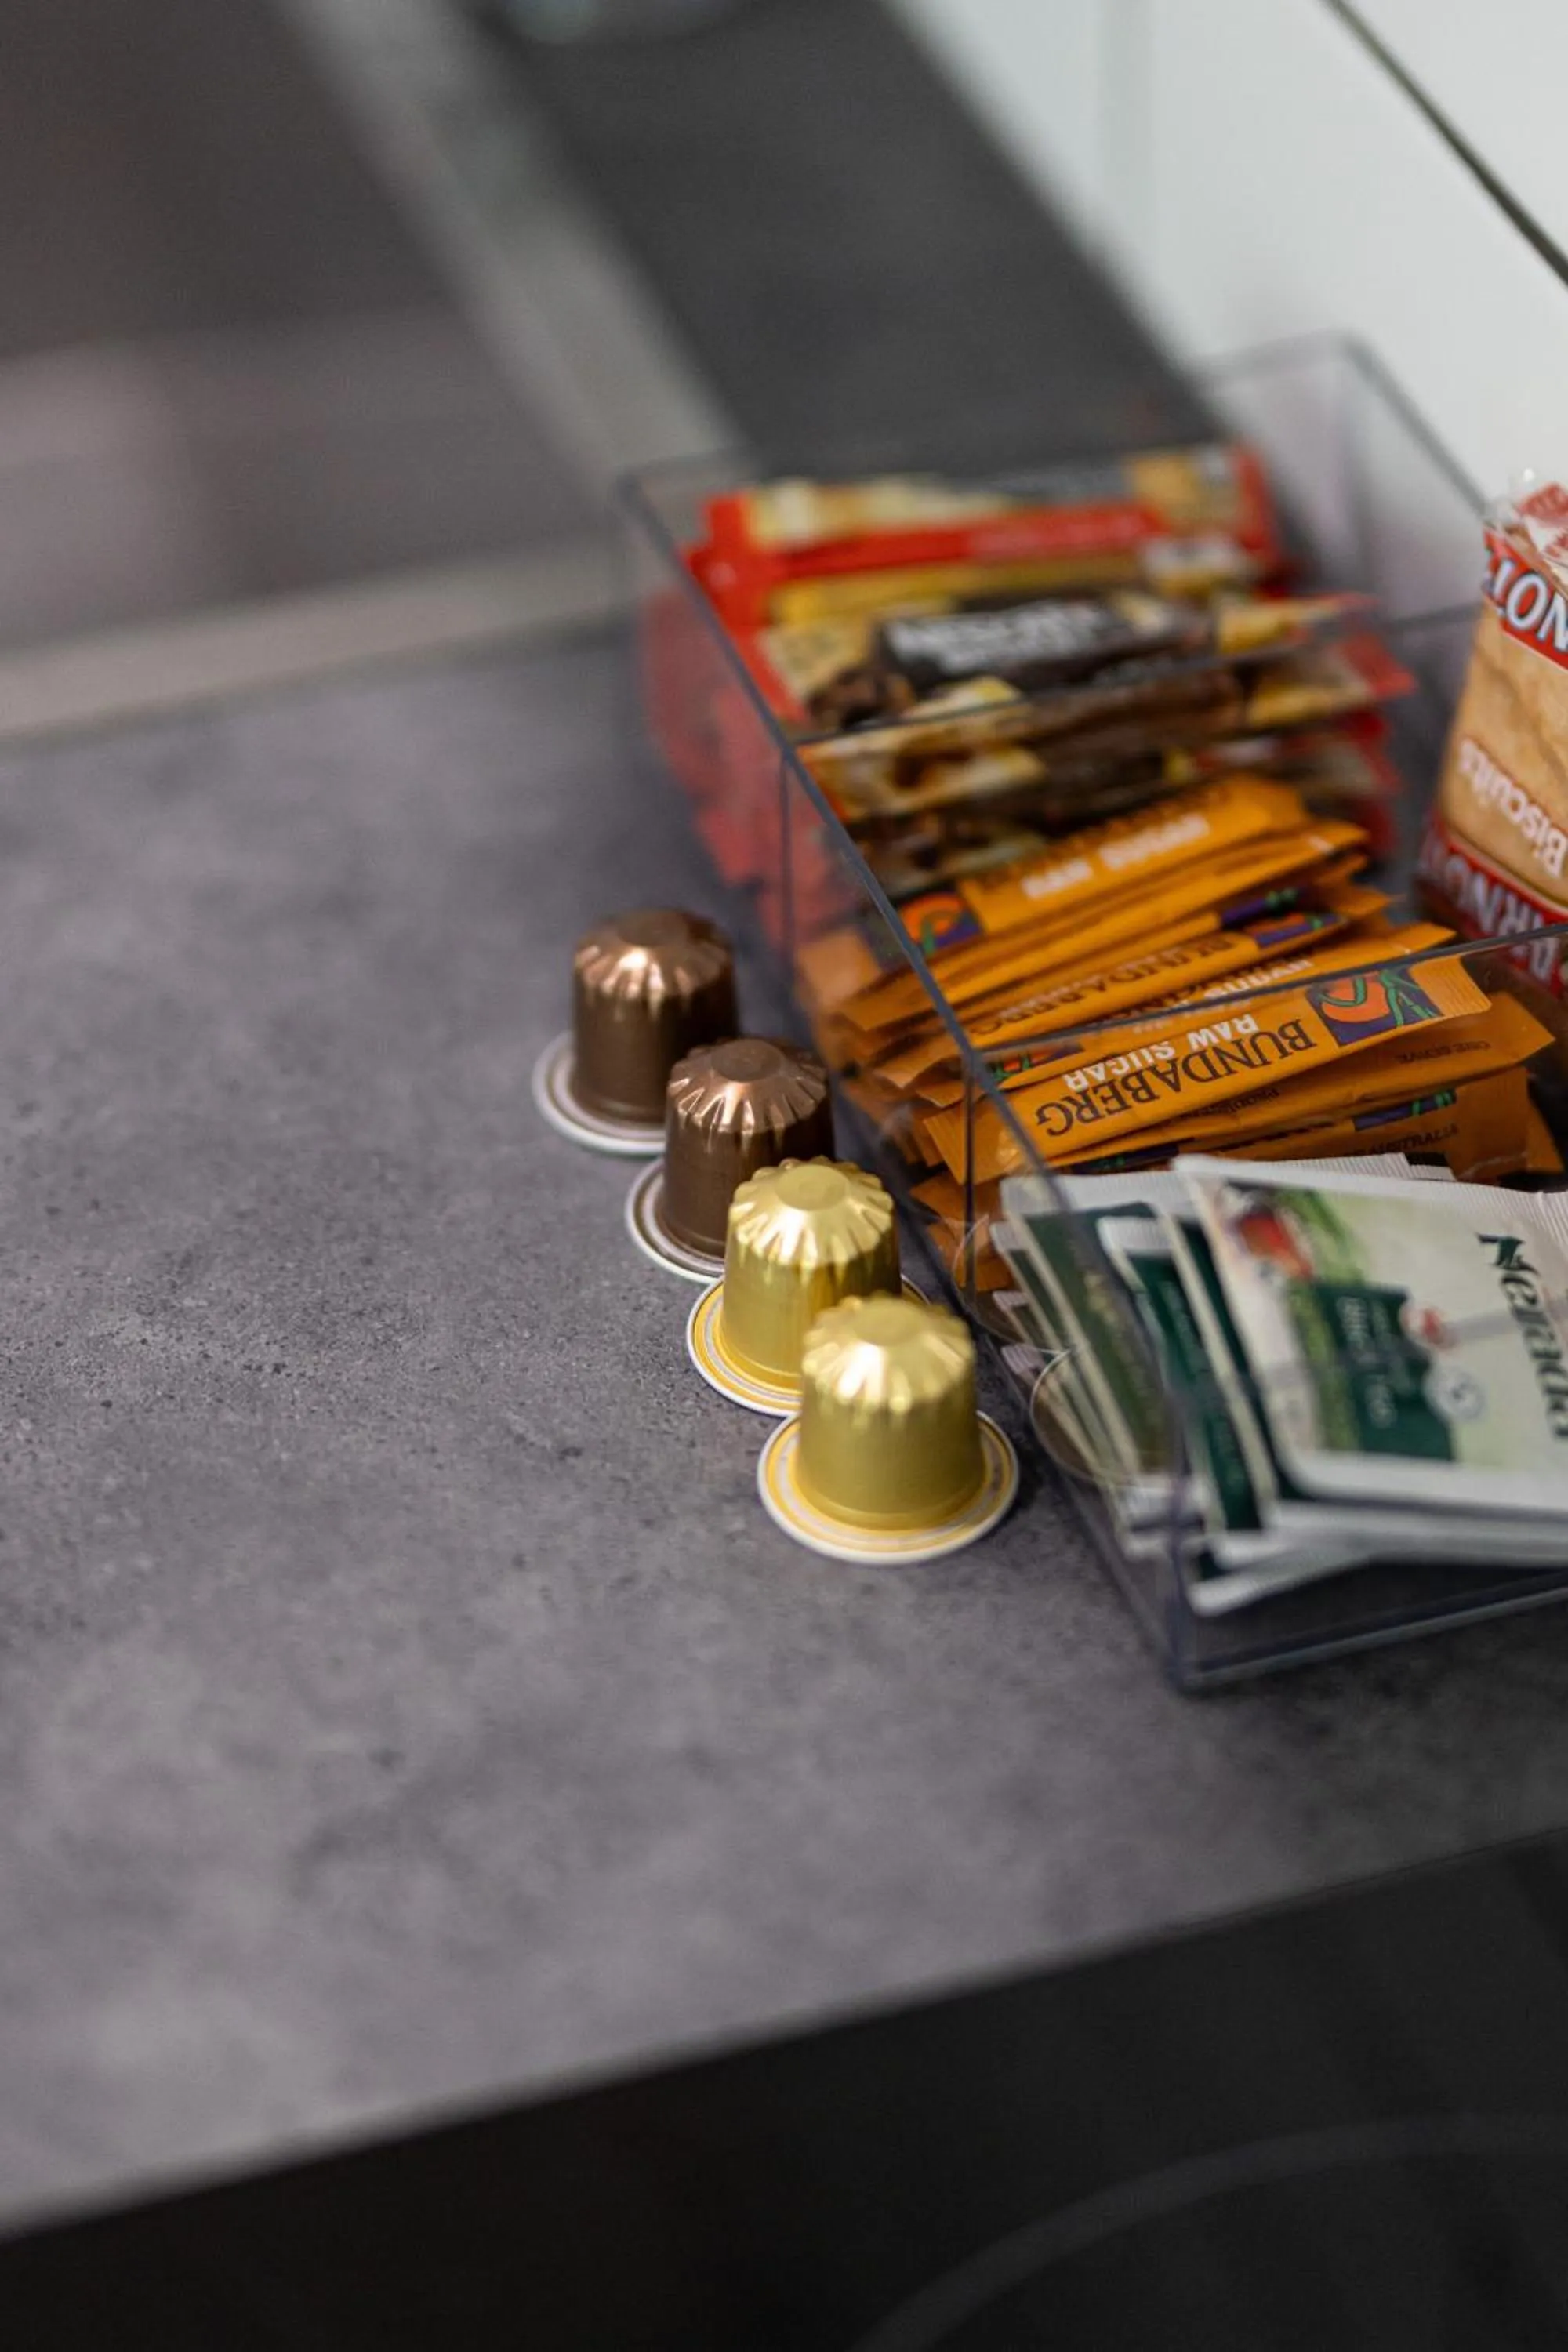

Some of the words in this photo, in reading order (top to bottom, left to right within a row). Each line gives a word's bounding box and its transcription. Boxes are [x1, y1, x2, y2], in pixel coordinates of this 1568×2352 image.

[1186, 1013, 1260, 1051] RAW
[1034, 1018, 1318, 1138] BUNDABERG
[1062, 1040, 1176, 1092] SUGAR
